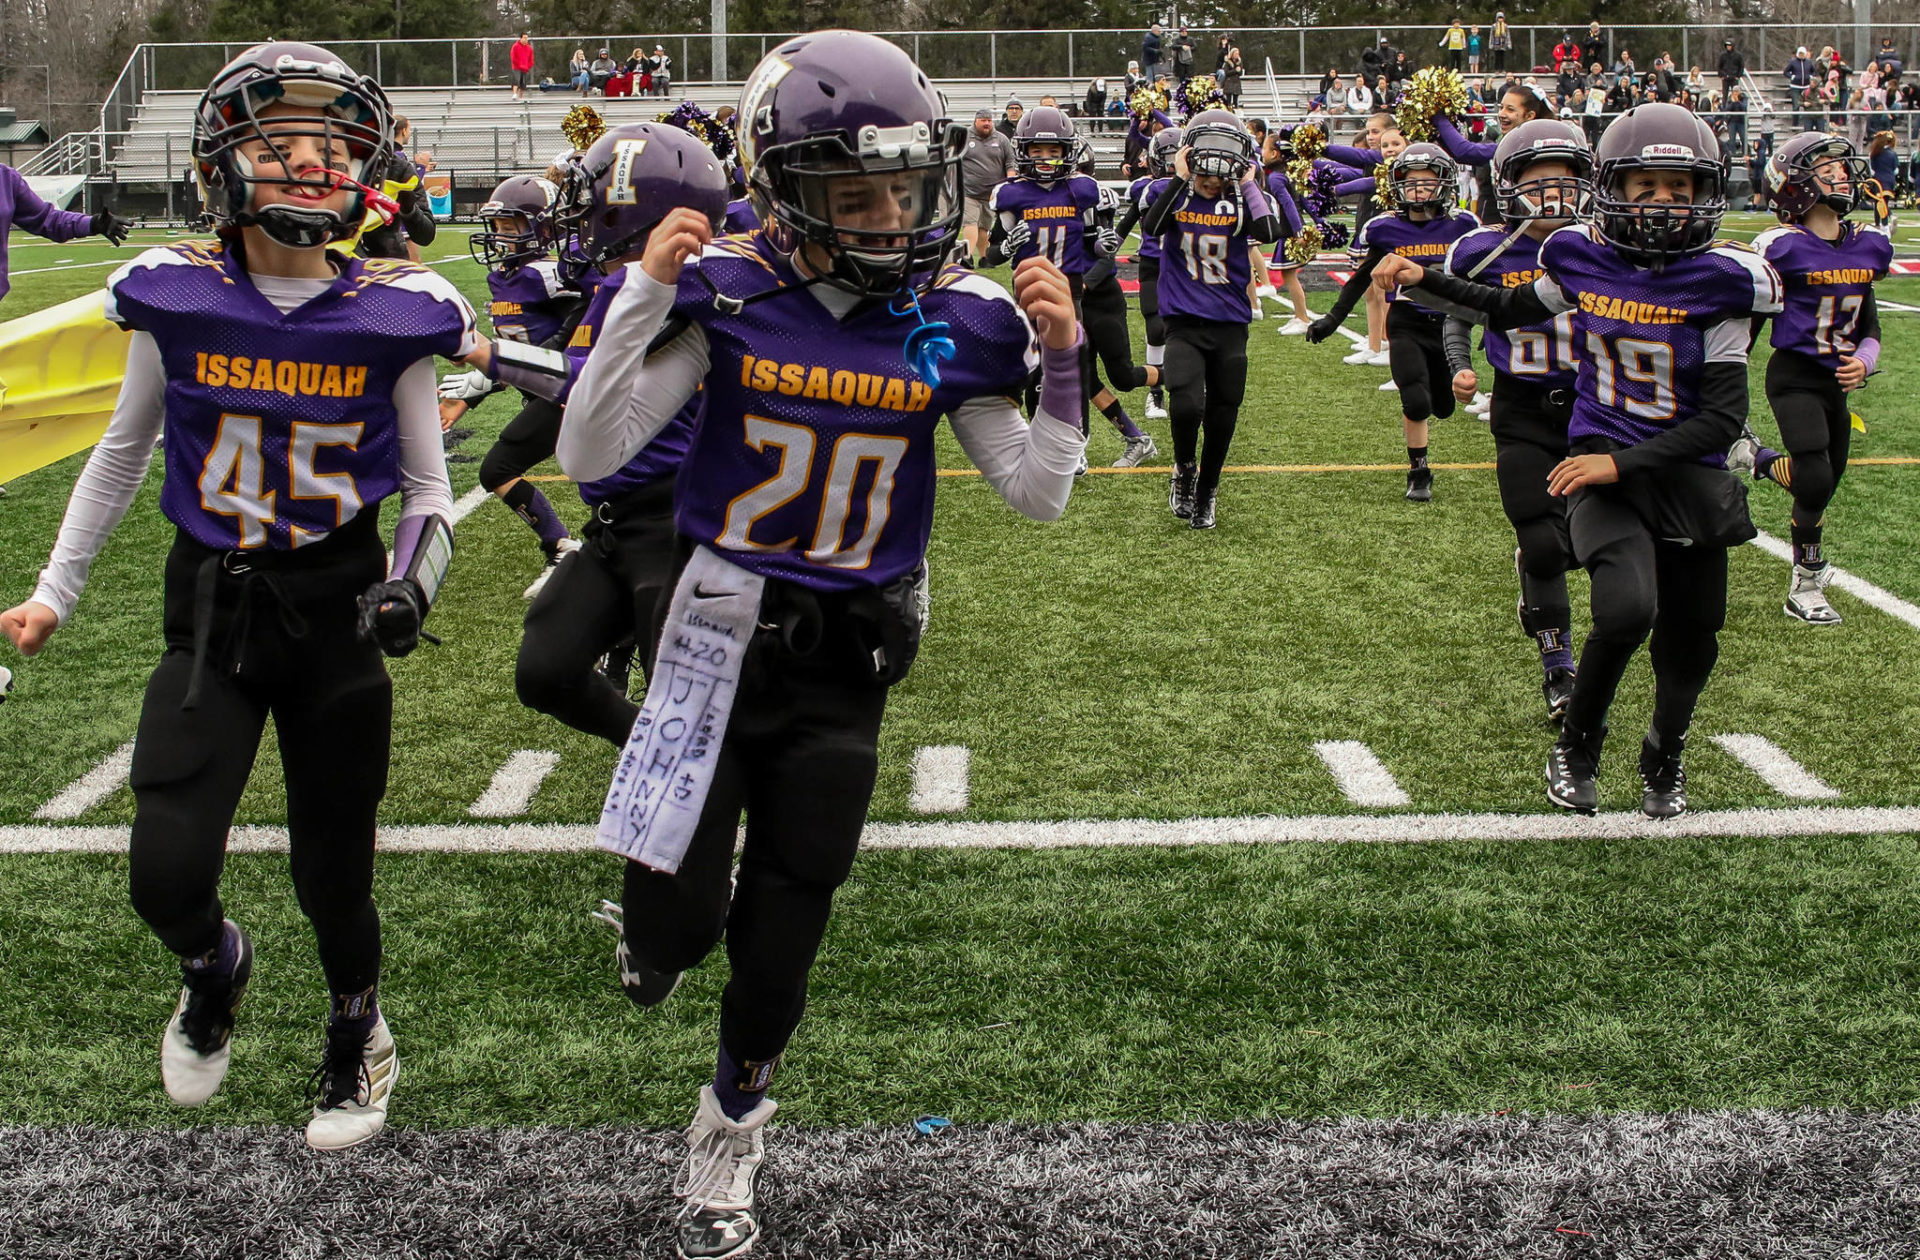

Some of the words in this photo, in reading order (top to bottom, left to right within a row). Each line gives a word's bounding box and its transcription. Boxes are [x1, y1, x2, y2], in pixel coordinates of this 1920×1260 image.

[1653, 145, 1682, 155] Riddell
[1036, 225, 1066, 269] 11
[1180, 231, 1230, 285] 18
[1815, 294, 1864, 354] 12
[196, 351, 368, 398] ISSAQUAH
[741, 354, 934, 413] ISSAQUAH
[1586, 330, 1677, 420] 19
[198, 412, 365, 550] 45
[714, 413, 909, 570] 20
